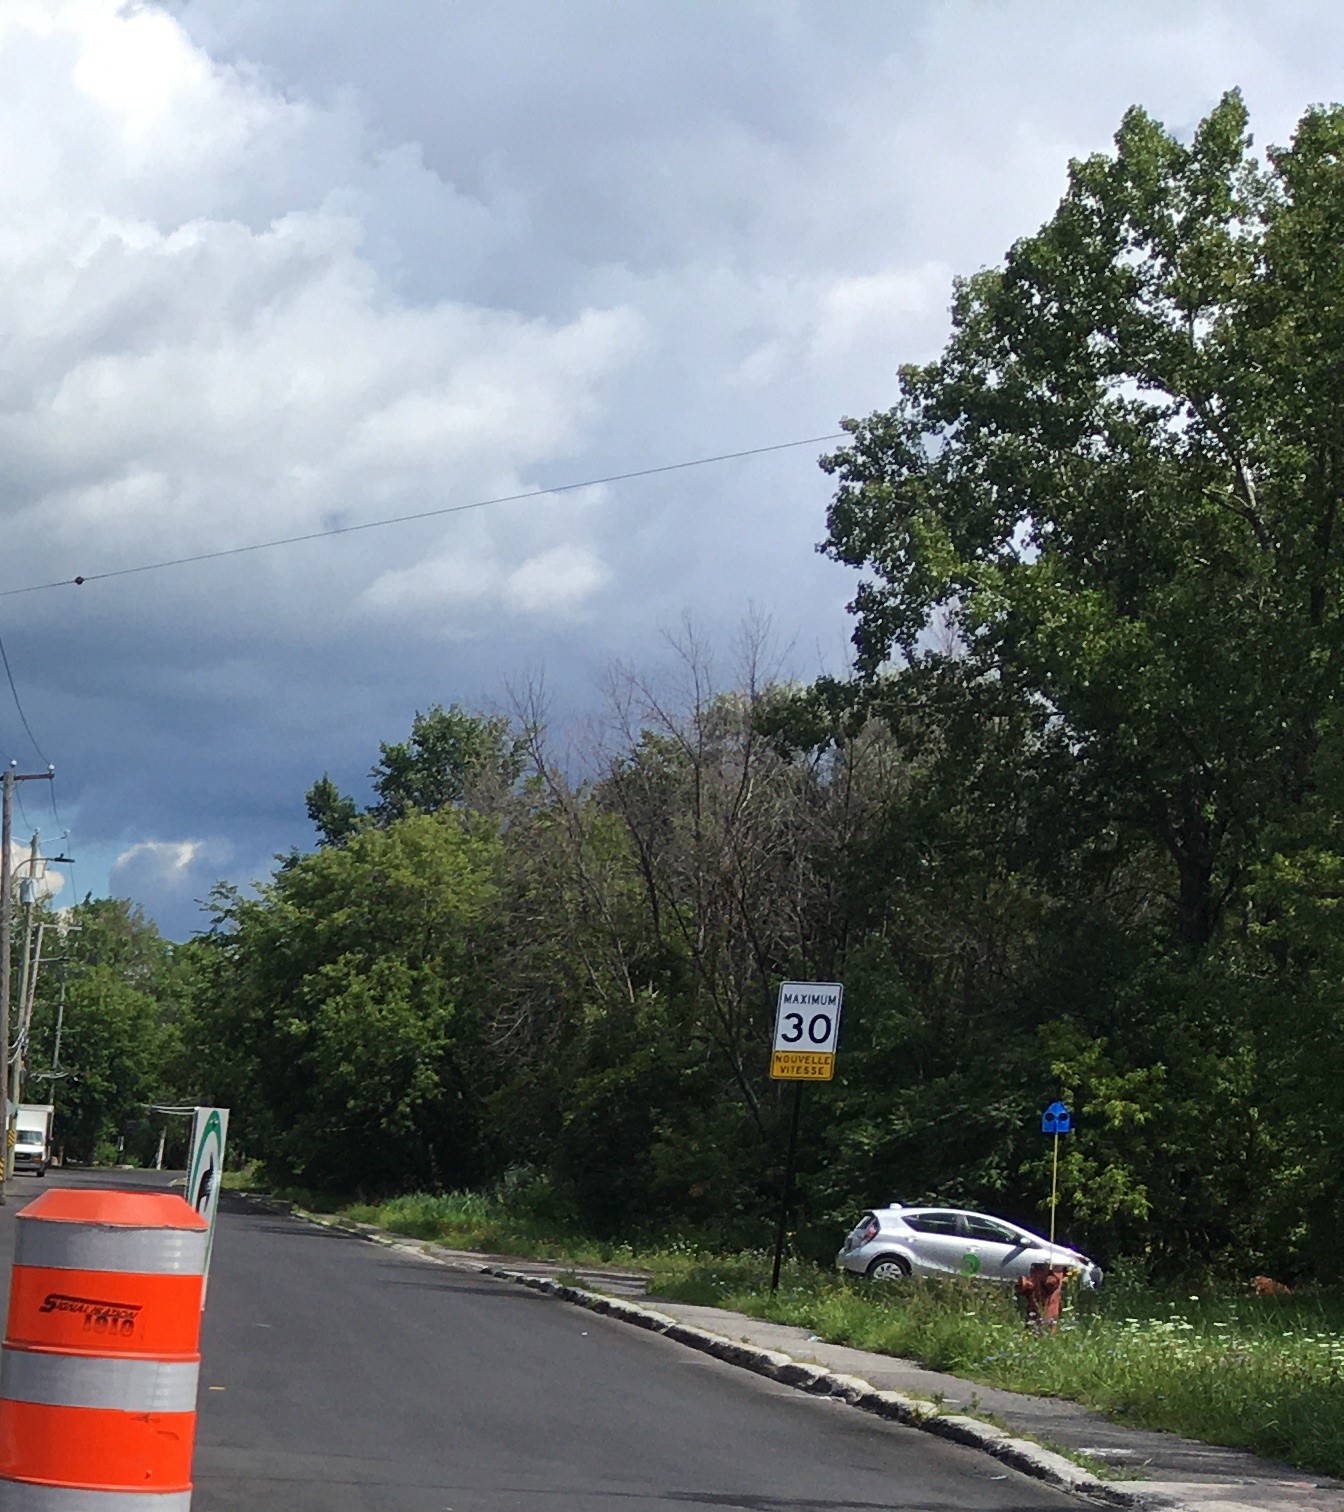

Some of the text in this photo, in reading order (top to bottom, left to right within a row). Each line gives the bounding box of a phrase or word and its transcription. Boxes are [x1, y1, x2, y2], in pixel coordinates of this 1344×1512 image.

[783, 993, 838, 1006] MAXIMUM
[780, 1012, 832, 1044] 30
[775, 1054, 831, 1065] NOUVELLE
[780, 1065, 825, 1076] VITESSE
